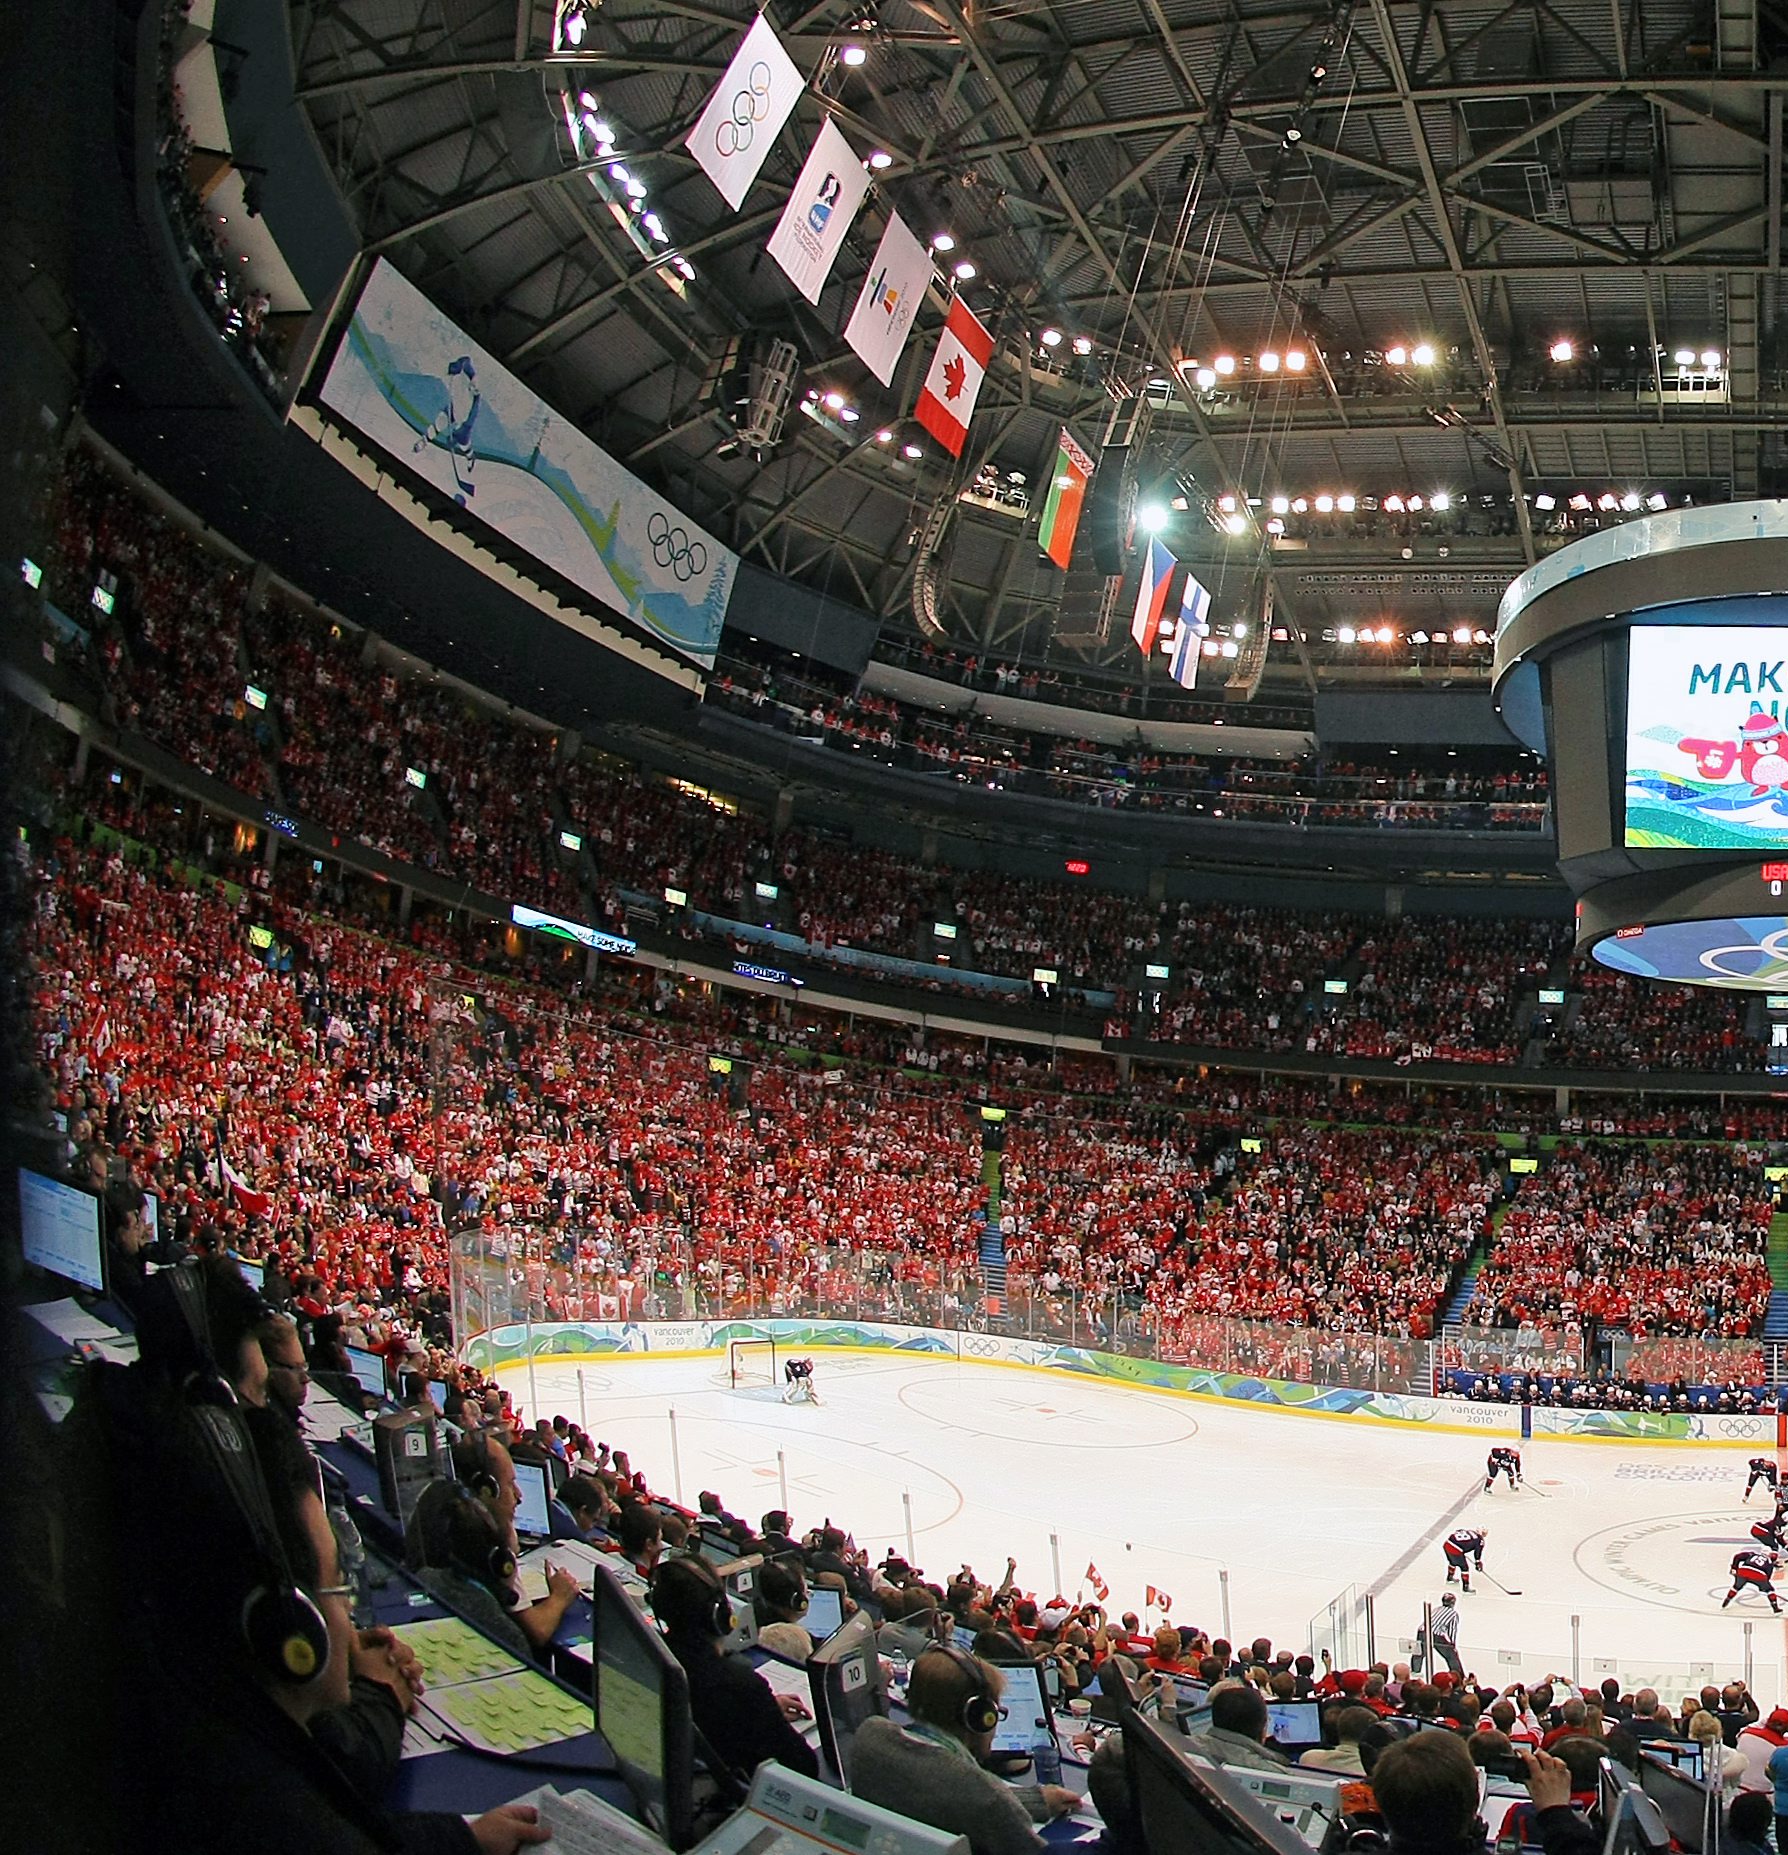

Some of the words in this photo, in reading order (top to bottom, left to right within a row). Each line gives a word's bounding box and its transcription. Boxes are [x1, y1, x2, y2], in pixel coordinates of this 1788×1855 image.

[1770, 880, 1782, 896] 0
[653, 1328, 695, 1336] vancouver
[665, 1337, 685, 1346] 2010
[1450, 1406, 1509, 1417] vancouver
[1466, 1415, 1493, 1424] 2010
[412, 1439, 419, 1451] 9
[1624, 1522, 1681, 1540] GAMES
[1684, 1515, 1770, 1525] vanco
[1750, 1555, 1768, 1567] 15
[848, 1665, 860, 1682] 10
